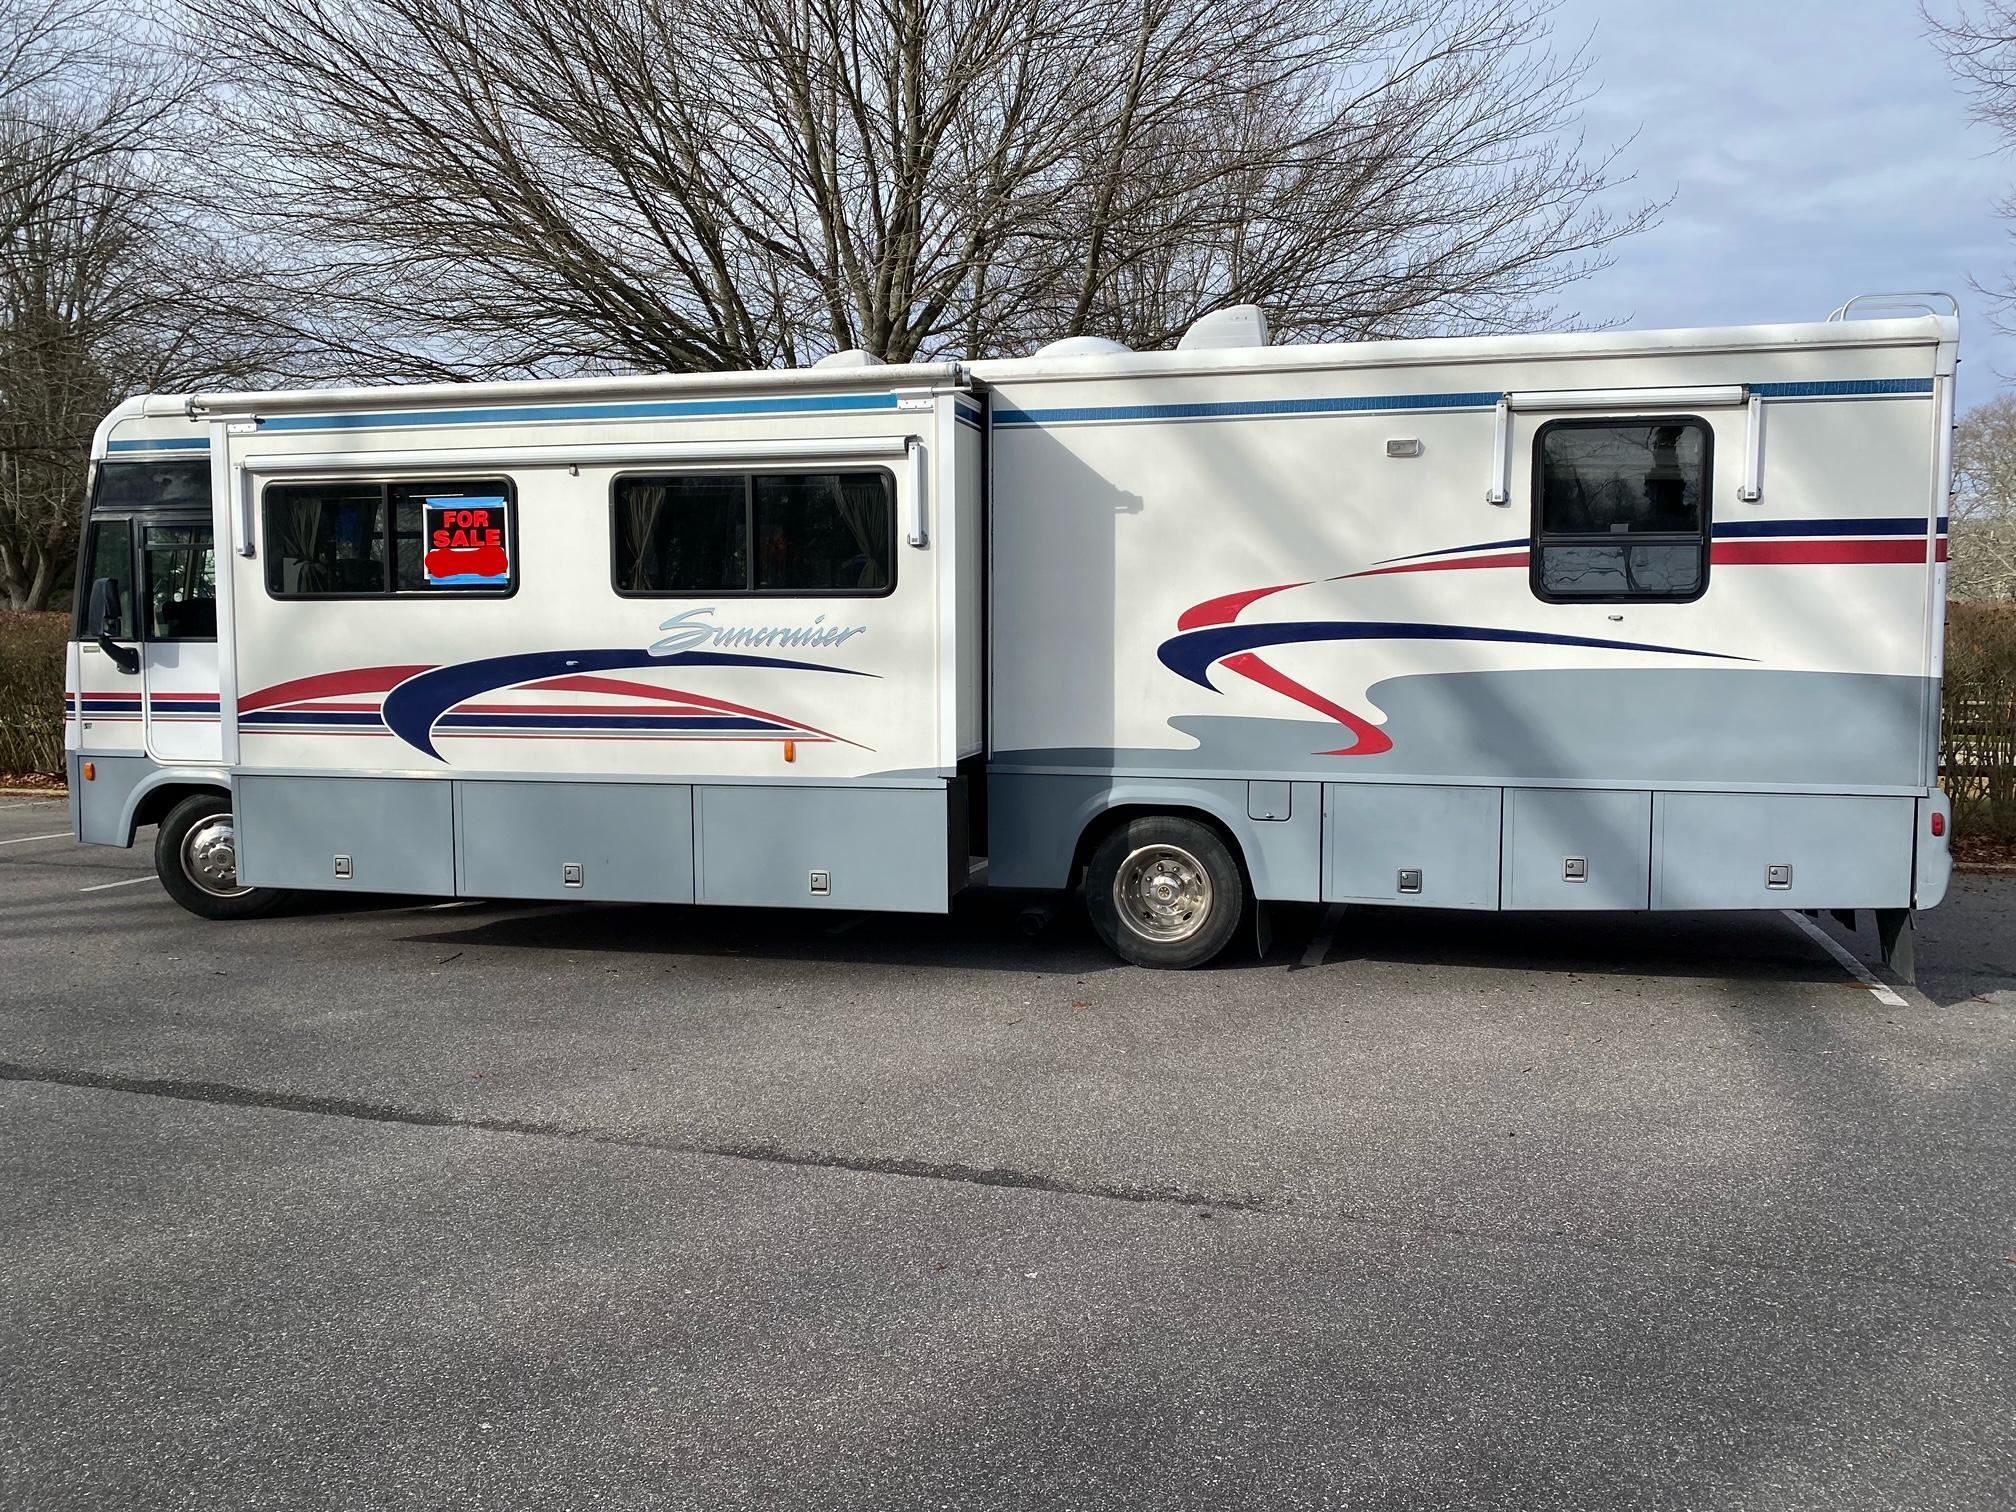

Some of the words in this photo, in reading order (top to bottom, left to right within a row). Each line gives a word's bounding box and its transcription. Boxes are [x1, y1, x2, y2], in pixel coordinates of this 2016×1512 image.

[443, 510, 489, 528] FOR
[433, 529, 501, 547] SALE
[647, 607, 867, 657] Suncruiser
